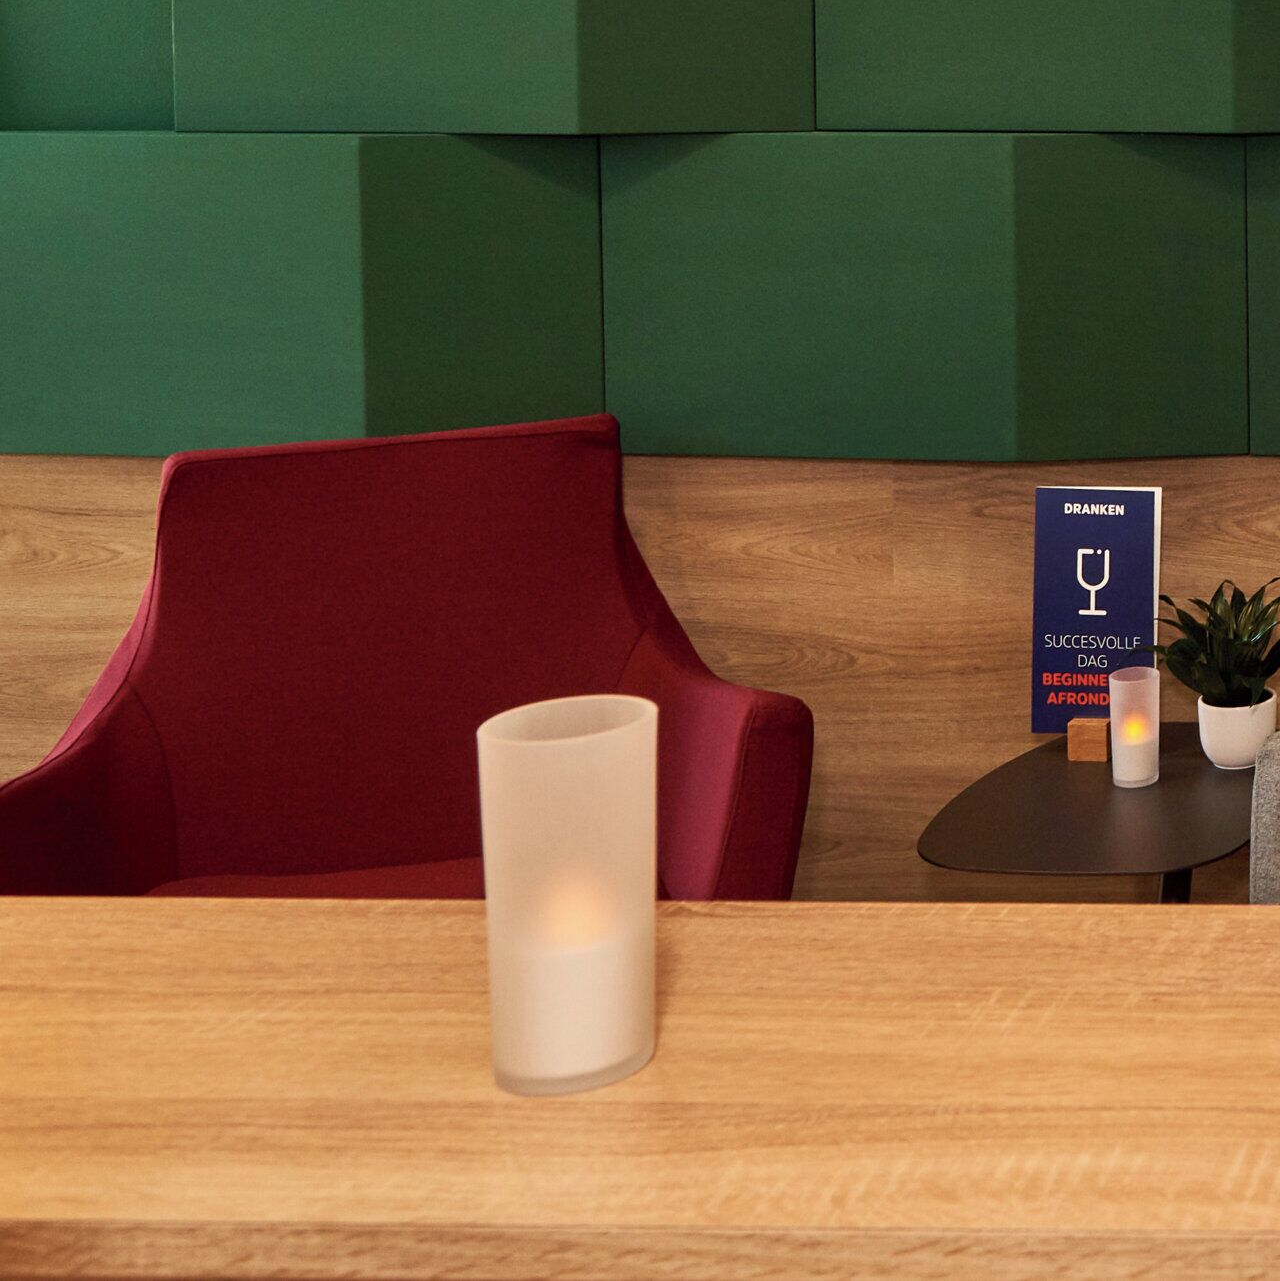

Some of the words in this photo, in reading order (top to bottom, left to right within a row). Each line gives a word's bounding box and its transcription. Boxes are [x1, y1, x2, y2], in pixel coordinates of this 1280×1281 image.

[1064, 503, 1125, 516] DRANKEN
[1044, 634, 1141, 650] SUCCESVOLLE
[1077, 654, 1108, 668] DAG
[1042, 672, 1109, 687] BEGINNE
[1046, 691, 1111, 706] AFROND
